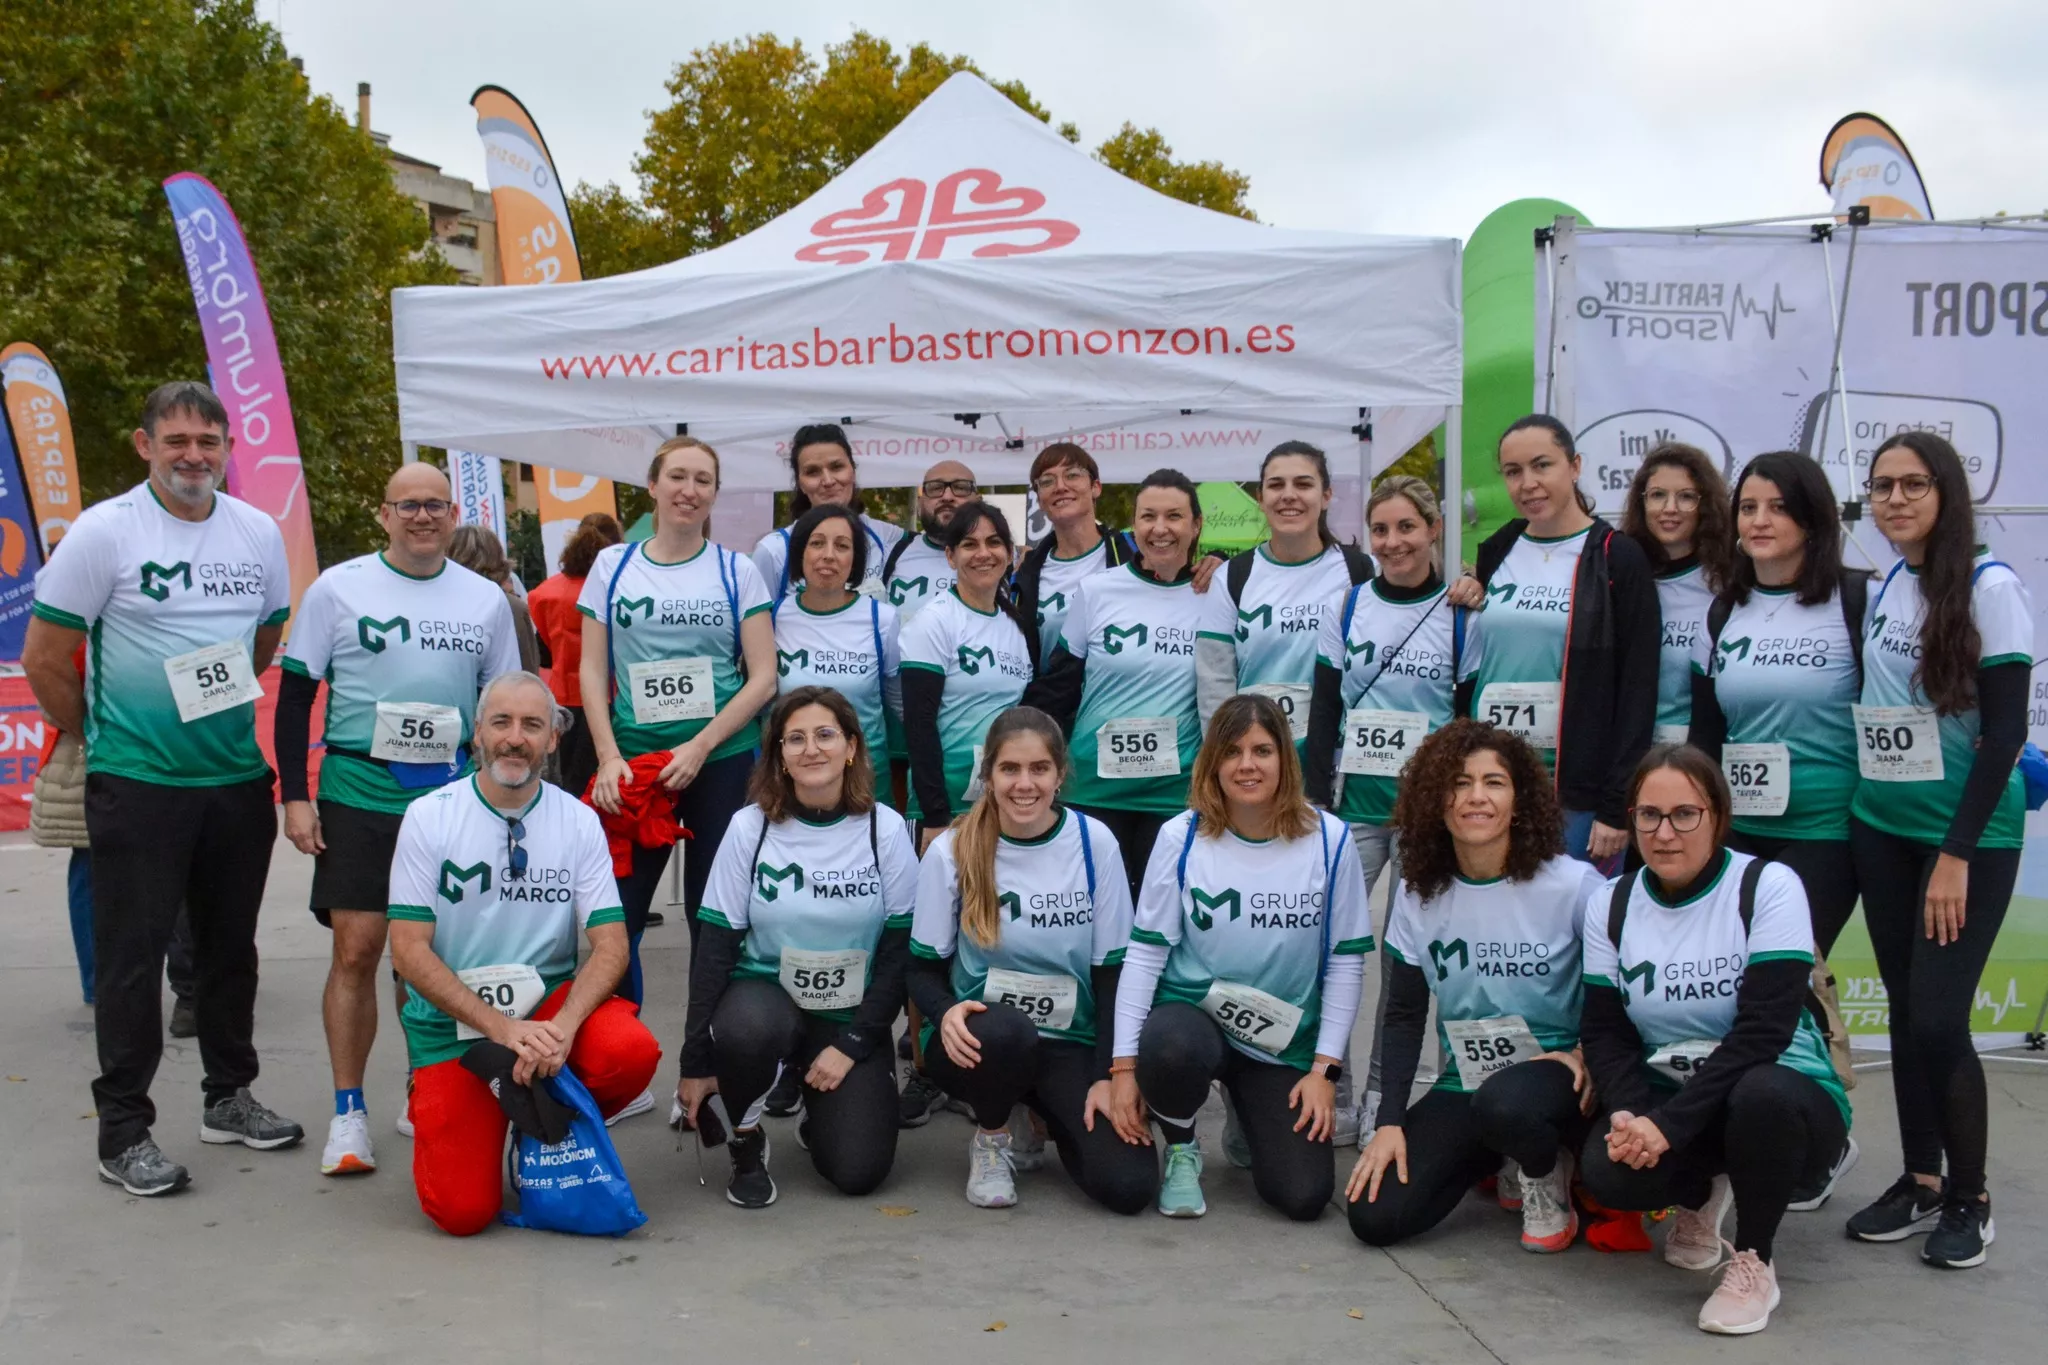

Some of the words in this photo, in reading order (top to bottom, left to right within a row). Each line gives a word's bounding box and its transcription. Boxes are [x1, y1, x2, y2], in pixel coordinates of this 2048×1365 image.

[541, 322, 1296, 381] www.caritasbarbastromonzon.es
[199, 562, 264, 580] GRUPO
[203, 580, 265, 598] MARCO
[661, 599, 724, 613] GRUPO
[1515, 599, 1570, 613] MARC
[661, 613, 724, 627] MARCO
[1280, 618, 1320, 634] MAR
[418, 620, 484, 639] GRUPO
[420, 637, 484, 656] MARCO
[1154, 642, 1195, 656] MAR
[1757, 636, 1829, 652] GRUPO
[815, 650, 868, 664] GRUPO
[1381, 645, 1443, 666] GRUPO
[1752, 653, 1827, 668] MARCO
[195, 662, 230, 688] 58
[814, 663, 869, 675] MARCO
[1380, 660, 1441, 681] MARCO
[202, 682, 237, 699] CARLOS
[643, 675, 694, 699] 566
[1488, 704, 1536, 728] 571
[400, 717, 435, 740] 56
[1507, 729, 1531, 738] ARIA
[385, 738, 411, 748] JUAN
[413, 741, 449, 750] CARLOS
[1111, 732, 1158, 754] 556
[1356, 727, 1406, 750] 564
[1864, 726, 1914, 751] 560
[1118, 753, 1156, 764] BEGOÑA
[1363, 750, 1396, 760] ISABEL
[1730, 763, 1769, 787] 562
[812, 864, 879, 882] GRUPO
[500, 886, 572, 904] MARCO
[813, 882, 880, 899] MARCO
[1250, 891, 1324, 910] GRUPO
[1251, 912, 1322, 929] MARCO
[1475, 942, 1549, 959] GRUPO
[1476, 961, 1550, 977] MARCO
[1664, 953, 1742, 981] GRUPO
[793, 968, 846, 990] 563
[801, 990, 839, 1000] RAQUEL
[1000, 992, 1054, 1016] 559
[1216, 1000, 1275, 1036] 567
[1464, 1037, 1516, 1062] 558
[1481, 1059, 1514, 1073] ALANA
